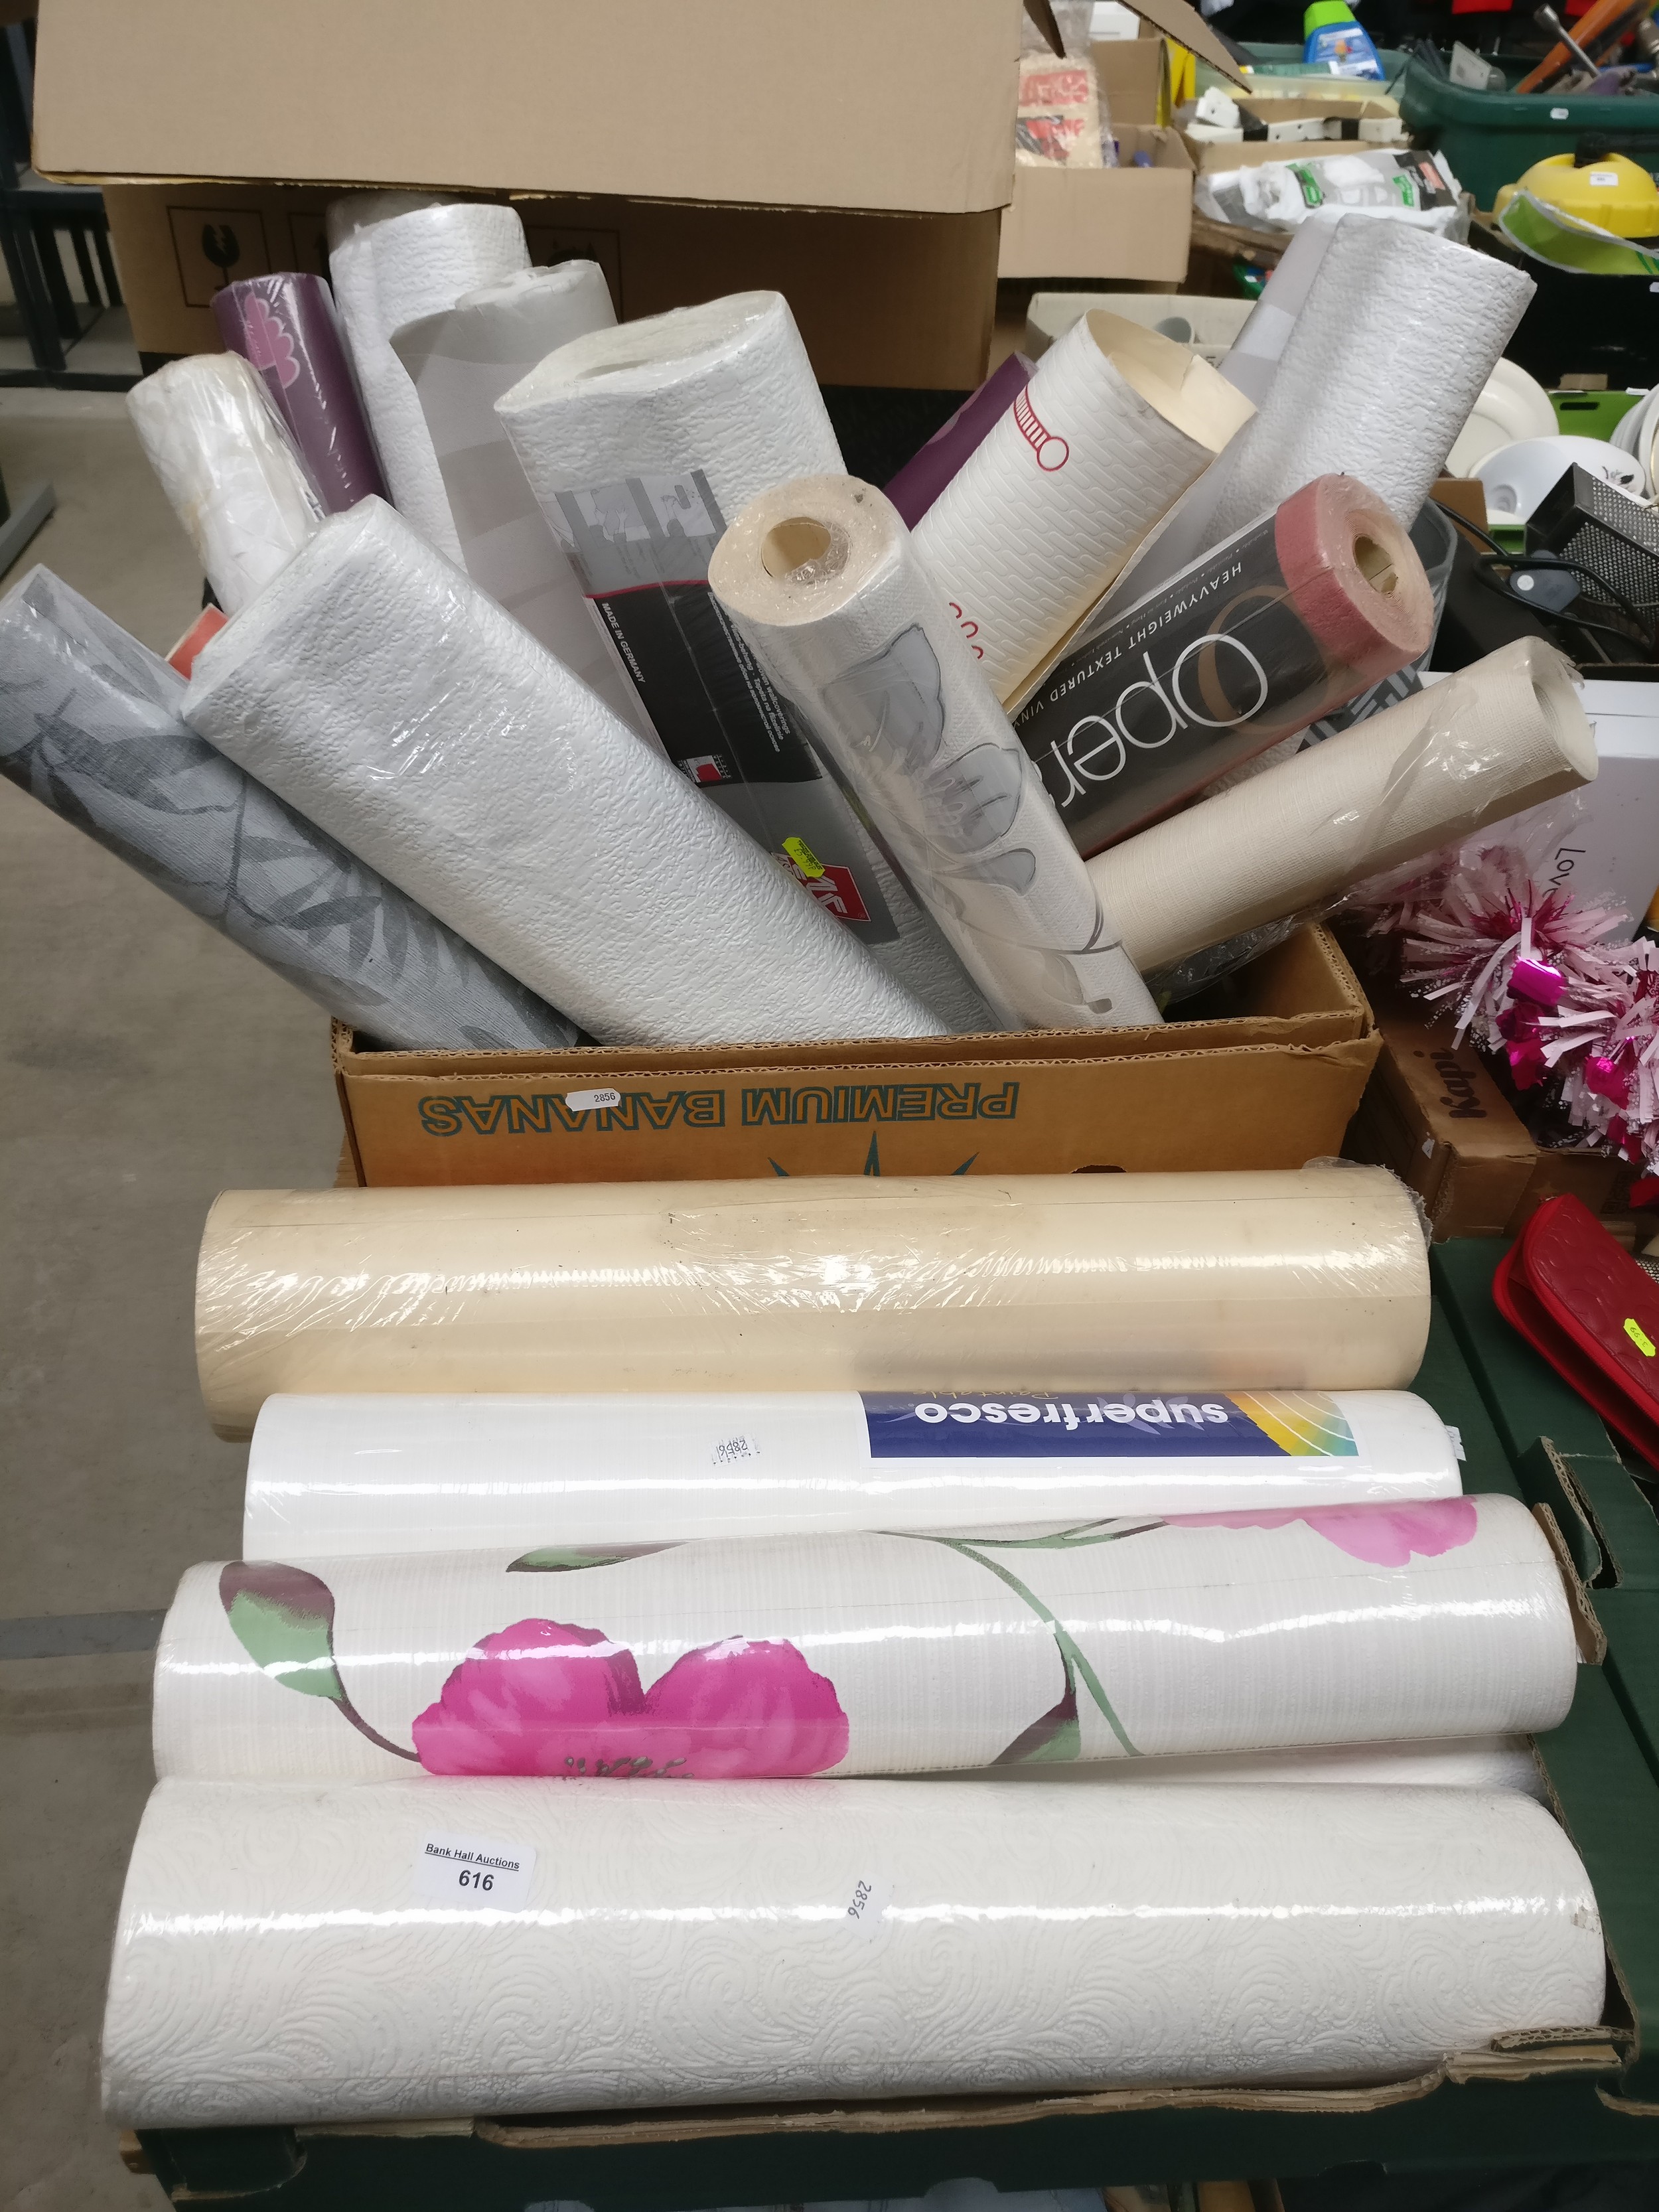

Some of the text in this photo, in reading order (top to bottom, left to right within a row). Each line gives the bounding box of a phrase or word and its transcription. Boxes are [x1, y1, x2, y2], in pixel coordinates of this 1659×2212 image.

[1128, 562, 1242, 650] HEAVYWEIGHT
[602, 602, 646, 683] MADE IN GERMANY
[1050, 646, 1122, 702] TEXTURED
[754, 678, 767, 701] Tapeta
[764, 702, 771, 711] na
[766, 686, 790, 735] wallcoverings
[1033, 634, 1268, 808] Oper
[417, 1081, 1019, 1137] PREMIUM BANANAS
[593, 1091, 616, 1103] 2856
[914, 1398, 1229, 1431] superfresco
[718, 1439, 749, 1457] 2856
[425, 1843, 520, 1870] Bank Hall Auctions
[459, 1869, 494, 1891] 616
[847, 1880, 872, 1919] 2856
